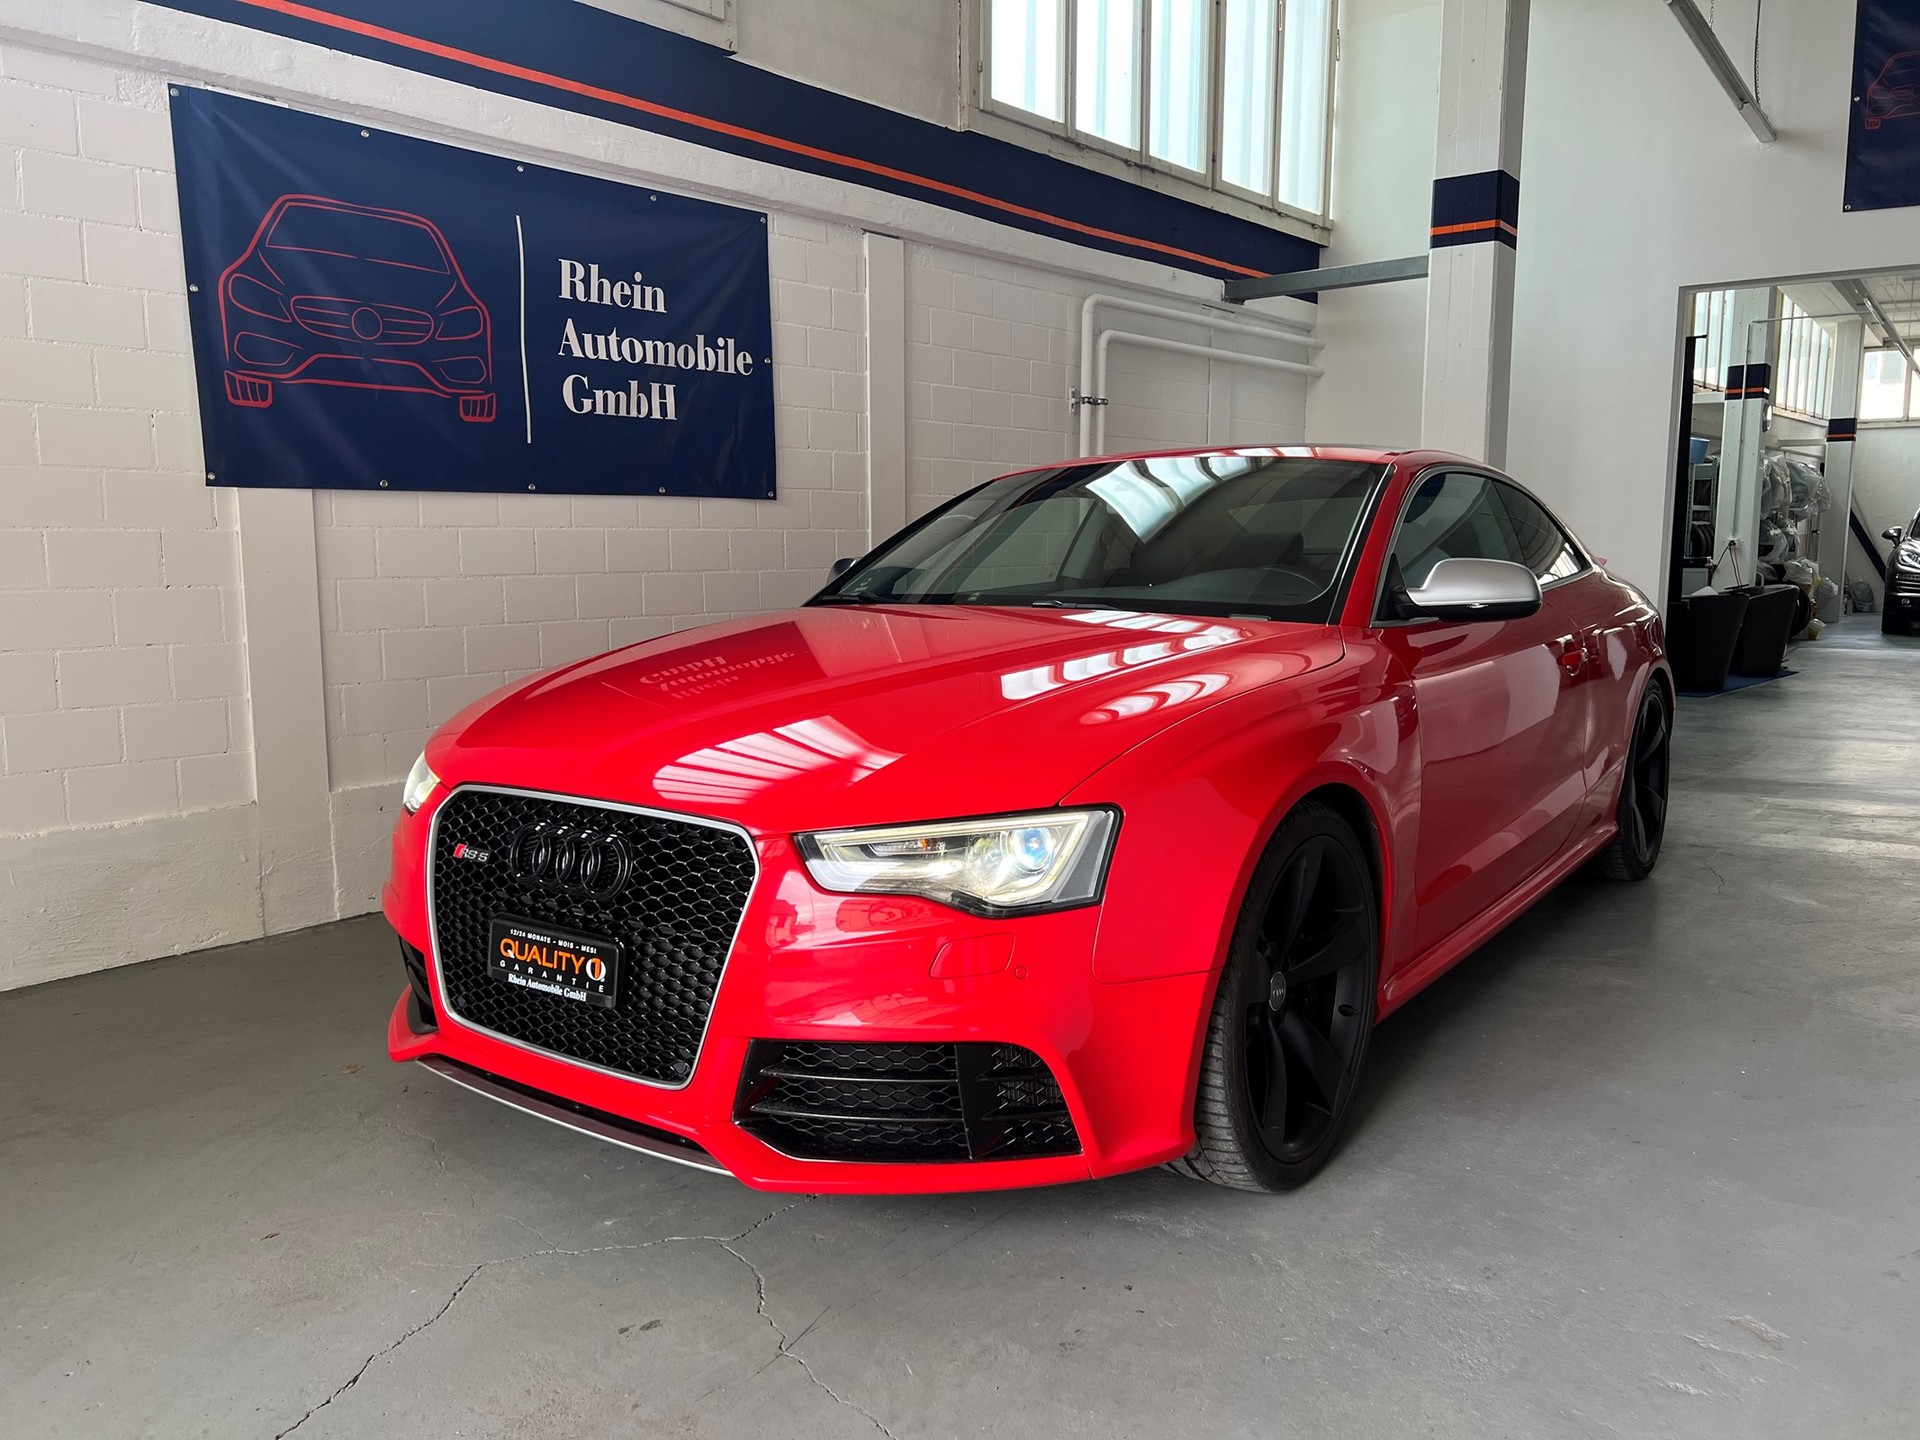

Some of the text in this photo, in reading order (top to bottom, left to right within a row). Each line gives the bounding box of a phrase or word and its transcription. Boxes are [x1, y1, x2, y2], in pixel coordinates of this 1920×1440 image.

[558, 258, 667, 313] Rhein
[558, 318, 753, 376] Automobile
[562, 374, 677, 420] GmbH
[500, 937, 585, 975] QUALITY
[527, 932, 551, 944] MONATE
[558, 939, 574, 949] MOIS
[581, 944, 597, 954] MESI
[500, 959, 604, 993] GARANTIE
[507, 972, 587, 1002] Rhein Automobile GmbH
